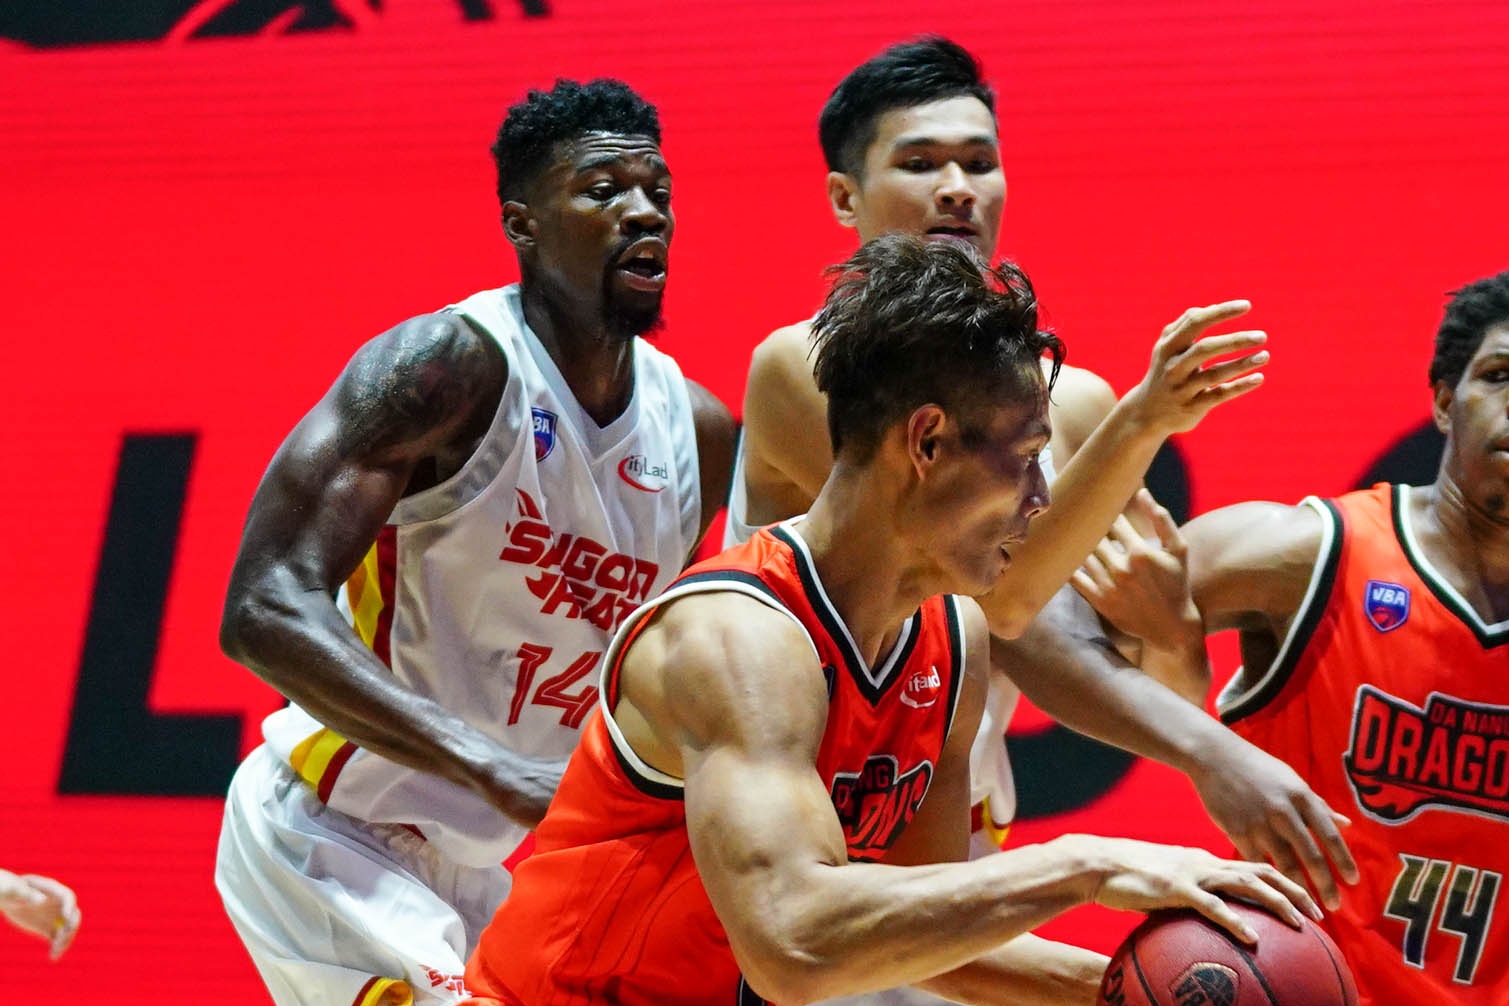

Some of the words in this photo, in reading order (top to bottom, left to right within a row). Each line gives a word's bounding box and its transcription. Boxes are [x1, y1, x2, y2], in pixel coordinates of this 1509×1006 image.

[1371, 586, 1406, 606] VBA
[507, 642, 603, 730] 14
[1431, 703, 1457, 727] DA
[1383, 852, 1503, 985] 44
